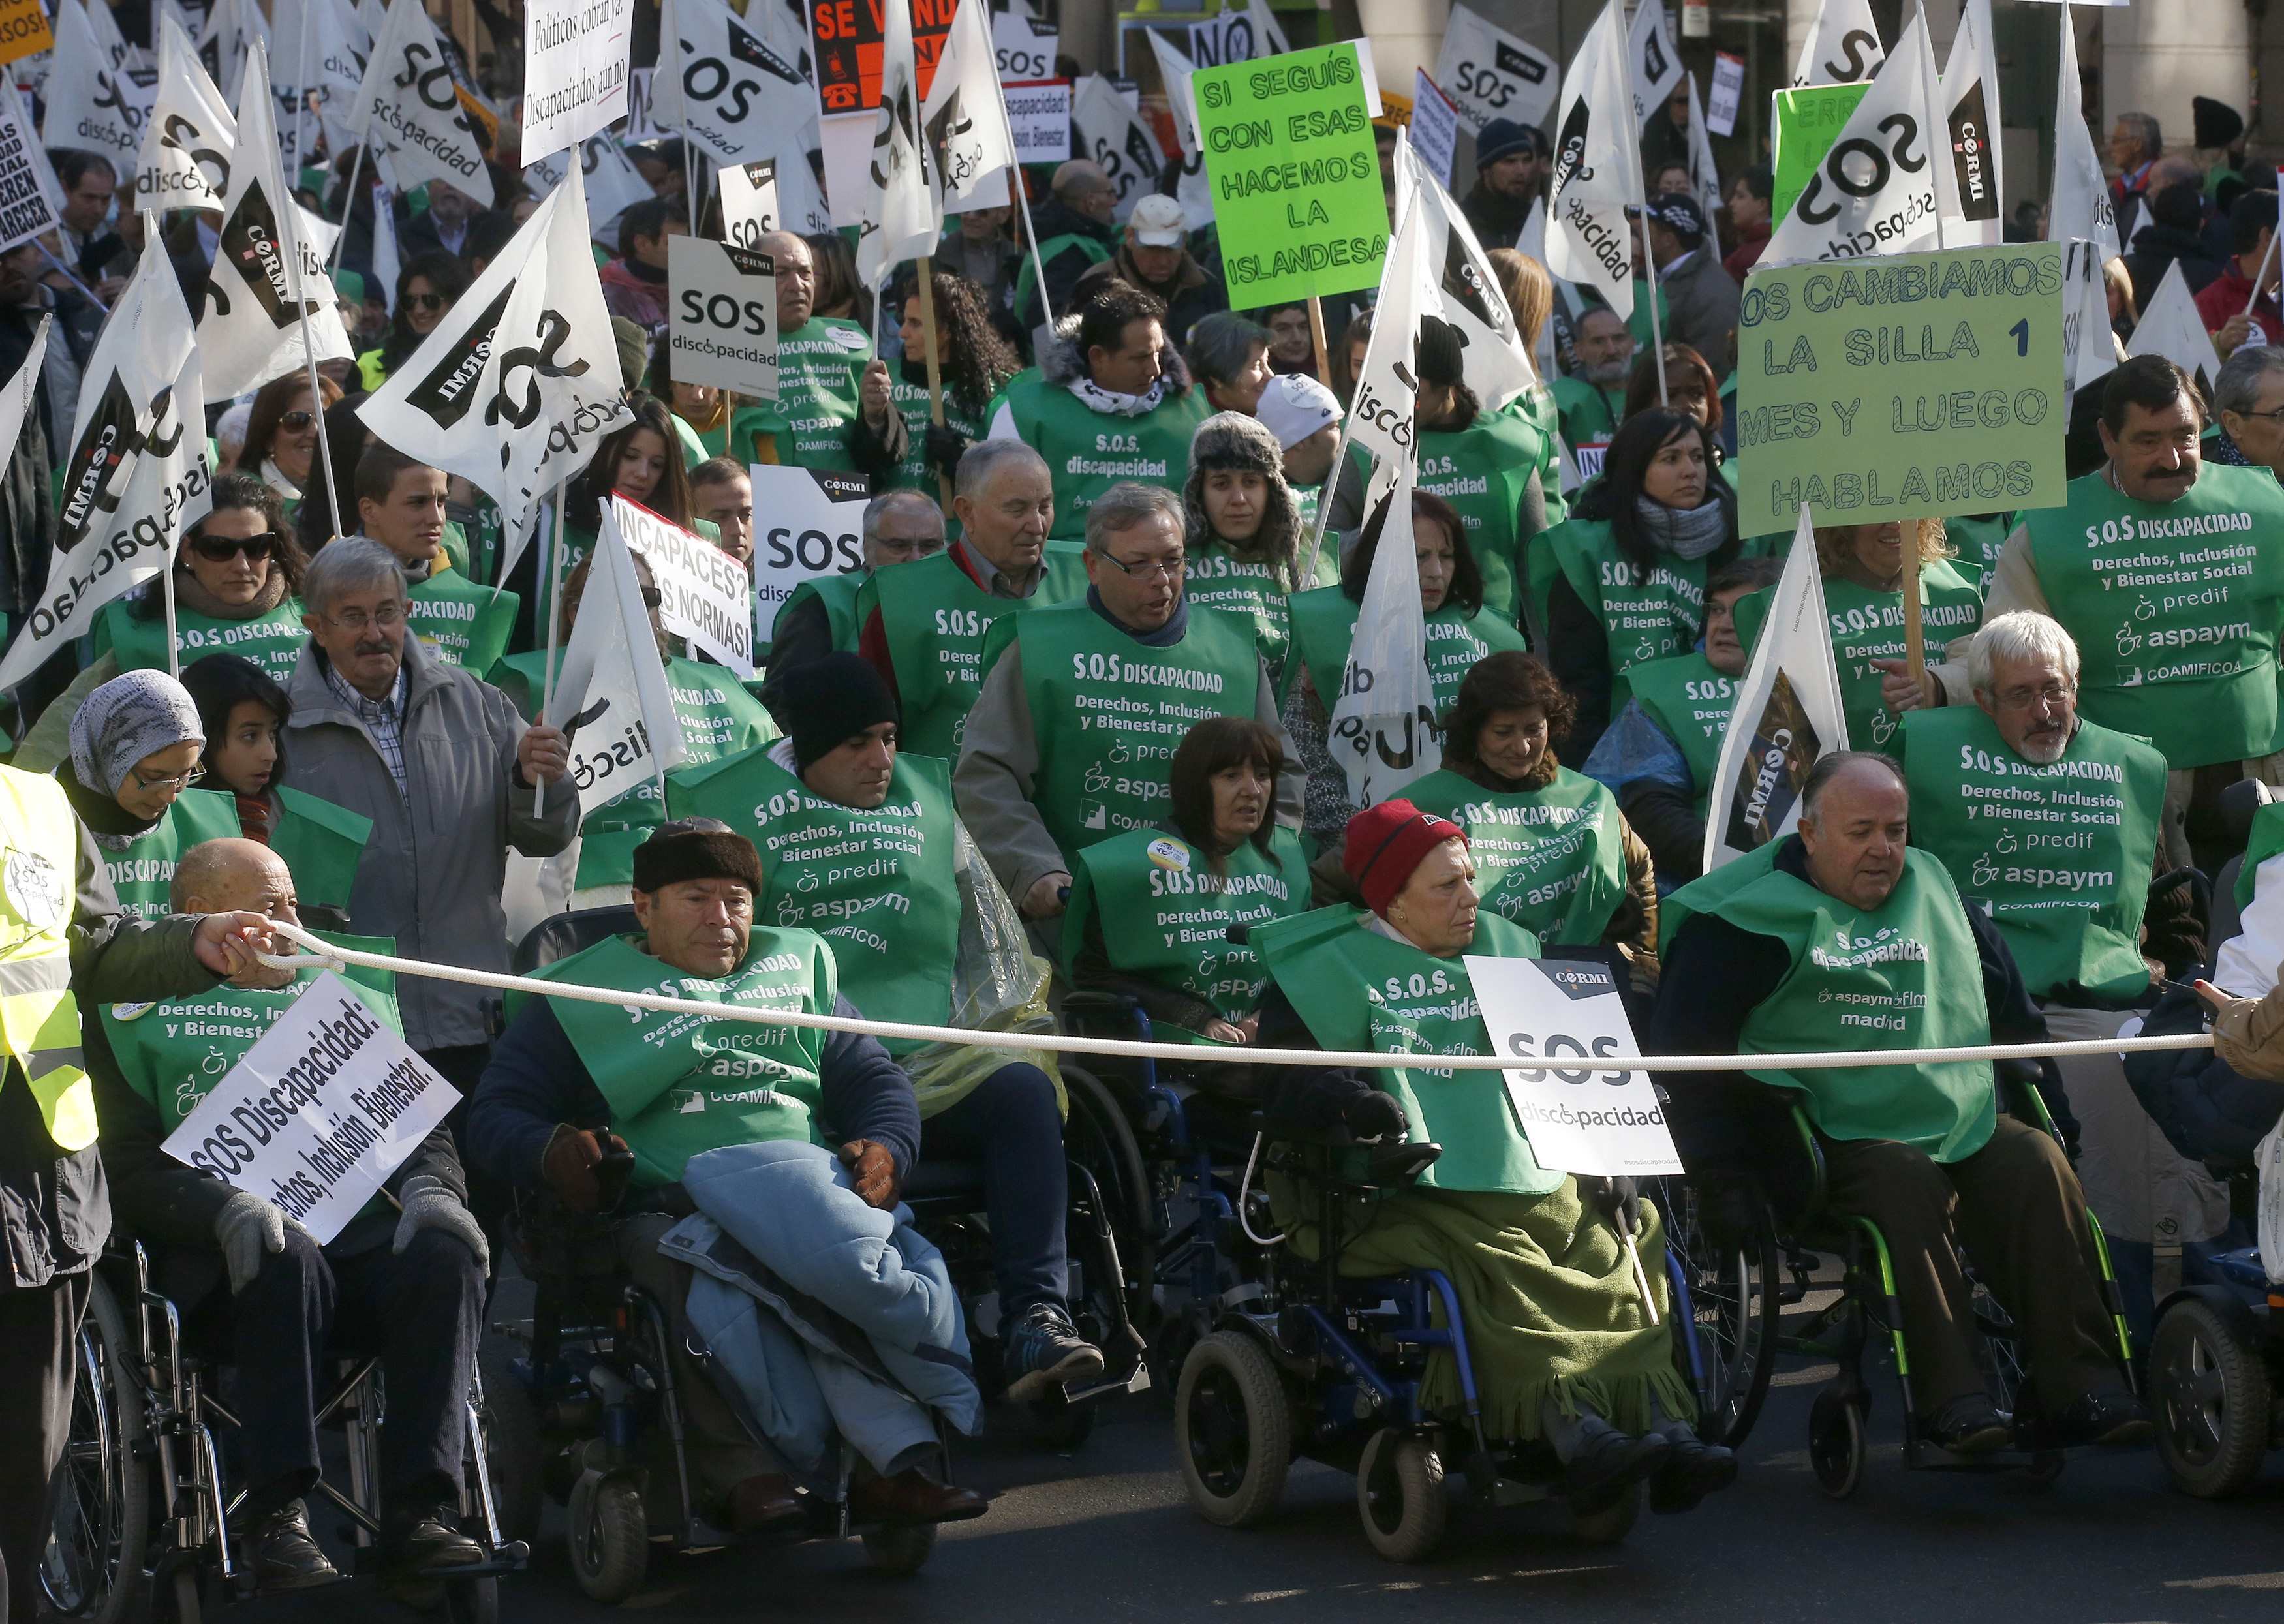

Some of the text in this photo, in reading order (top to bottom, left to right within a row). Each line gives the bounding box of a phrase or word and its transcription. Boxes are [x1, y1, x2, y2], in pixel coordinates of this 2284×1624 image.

[816, 3, 856, 40] SE
[996, 48, 1046, 77] SOS
[683, 57, 762, 123] OS
[1203, 50, 1354, 108] SI SEGUÍS
[1456, 61, 1517, 108] SOS
[525, 67, 597, 129] Discapacitados,
[1209, 119, 1273, 153] CON
[1288, 105, 1366, 142] ESAS
[1221, 152, 1370, 200] HACEMOS
[1288, 200, 1329, 228] LA
[1227, 234, 1387, 285] ISLANDESA
[1740, 255, 2063, 326] OS CAMBIAMOS
[681, 289, 765, 336] SOS
[1764, 318, 2029, 375] LA SILLA 1
[1738, 388, 2048, 448] MES Y LUEGO
[1096, 435, 1140, 452] S.O.S.
[1067, 456, 1166, 477] discapacidad
[1772, 460, 2033, 516] HABLAMOS
[2086, 512, 2253, 548] S.O.S DISCAPACIDAD
[767, 527, 863, 573] SOS
[2092, 545, 2257, 571] Derechos, Inclusión
[1186, 556, 1227, 580] S.O.S
[2102, 562, 2253, 590] y Bienestar Social
[1189, 588, 1263, 604] Derechos,
[2163, 587, 2229, 612] predif
[679, 585, 750, 661] NORMAS!
[935, 609, 978, 637] S.O.S
[1609, 619, 1618, 631] y
[1832, 605, 1880, 634] S.O.S
[2148, 622, 2250, 648] aspaym
[1845, 641, 1907, 658] Derecho
[1073, 653, 1223, 694] S.O.S DISCAPACIDAD
[2147, 660, 2242, 681] COAMIFICOA
[1686, 677, 1731, 700] S.O.S
[1075, 694, 1154, 716] Derechos,
[1081, 715, 1173, 735] y Bienestar
[1960, 745, 2122, 784] S.O.S DISCAPACIDAD
[754, 789, 800, 827] S.O.S
[1961, 784, 2124, 810] Derechos, Inclusión
[1451, 801, 1496, 829] S.O.S
[1968, 805, 2121, 825] y Bienestar Social
[767, 821, 925, 851] Derechos, Inclusión
[782, 838, 922, 862] Bienestar Social
[2027, 832, 2093, 850] predif
[828, 859, 898, 885] predif
[1474, 855, 1483, 868] y
[1149, 866, 1194, 897] S.O.S
[2005, 867, 2114, 891] aspaym
[811, 893, 910, 919] aspaym
[1157, 908, 1233, 925] Derechos,
[1999, 900, 2100, 911] COAMIFICOA
[1164, 927, 1226, 947] y Biene
[1836, 927, 1898, 951] S.O.S.
[1226, 951, 1258, 966] pre
[1385, 970, 1455, 1000] S.O.S.
[158, 1002, 258, 1021] Derechos,
[1835, 992, 1892, 1007] aspaym
[166, 1024, 178, 1038] y
[230, 998, 379, 1146] Discapacidad:
[1509, 1033, 1632, 1086] SOS
[298, 1056, 433, 1186] Inclusión, Bienestar.
